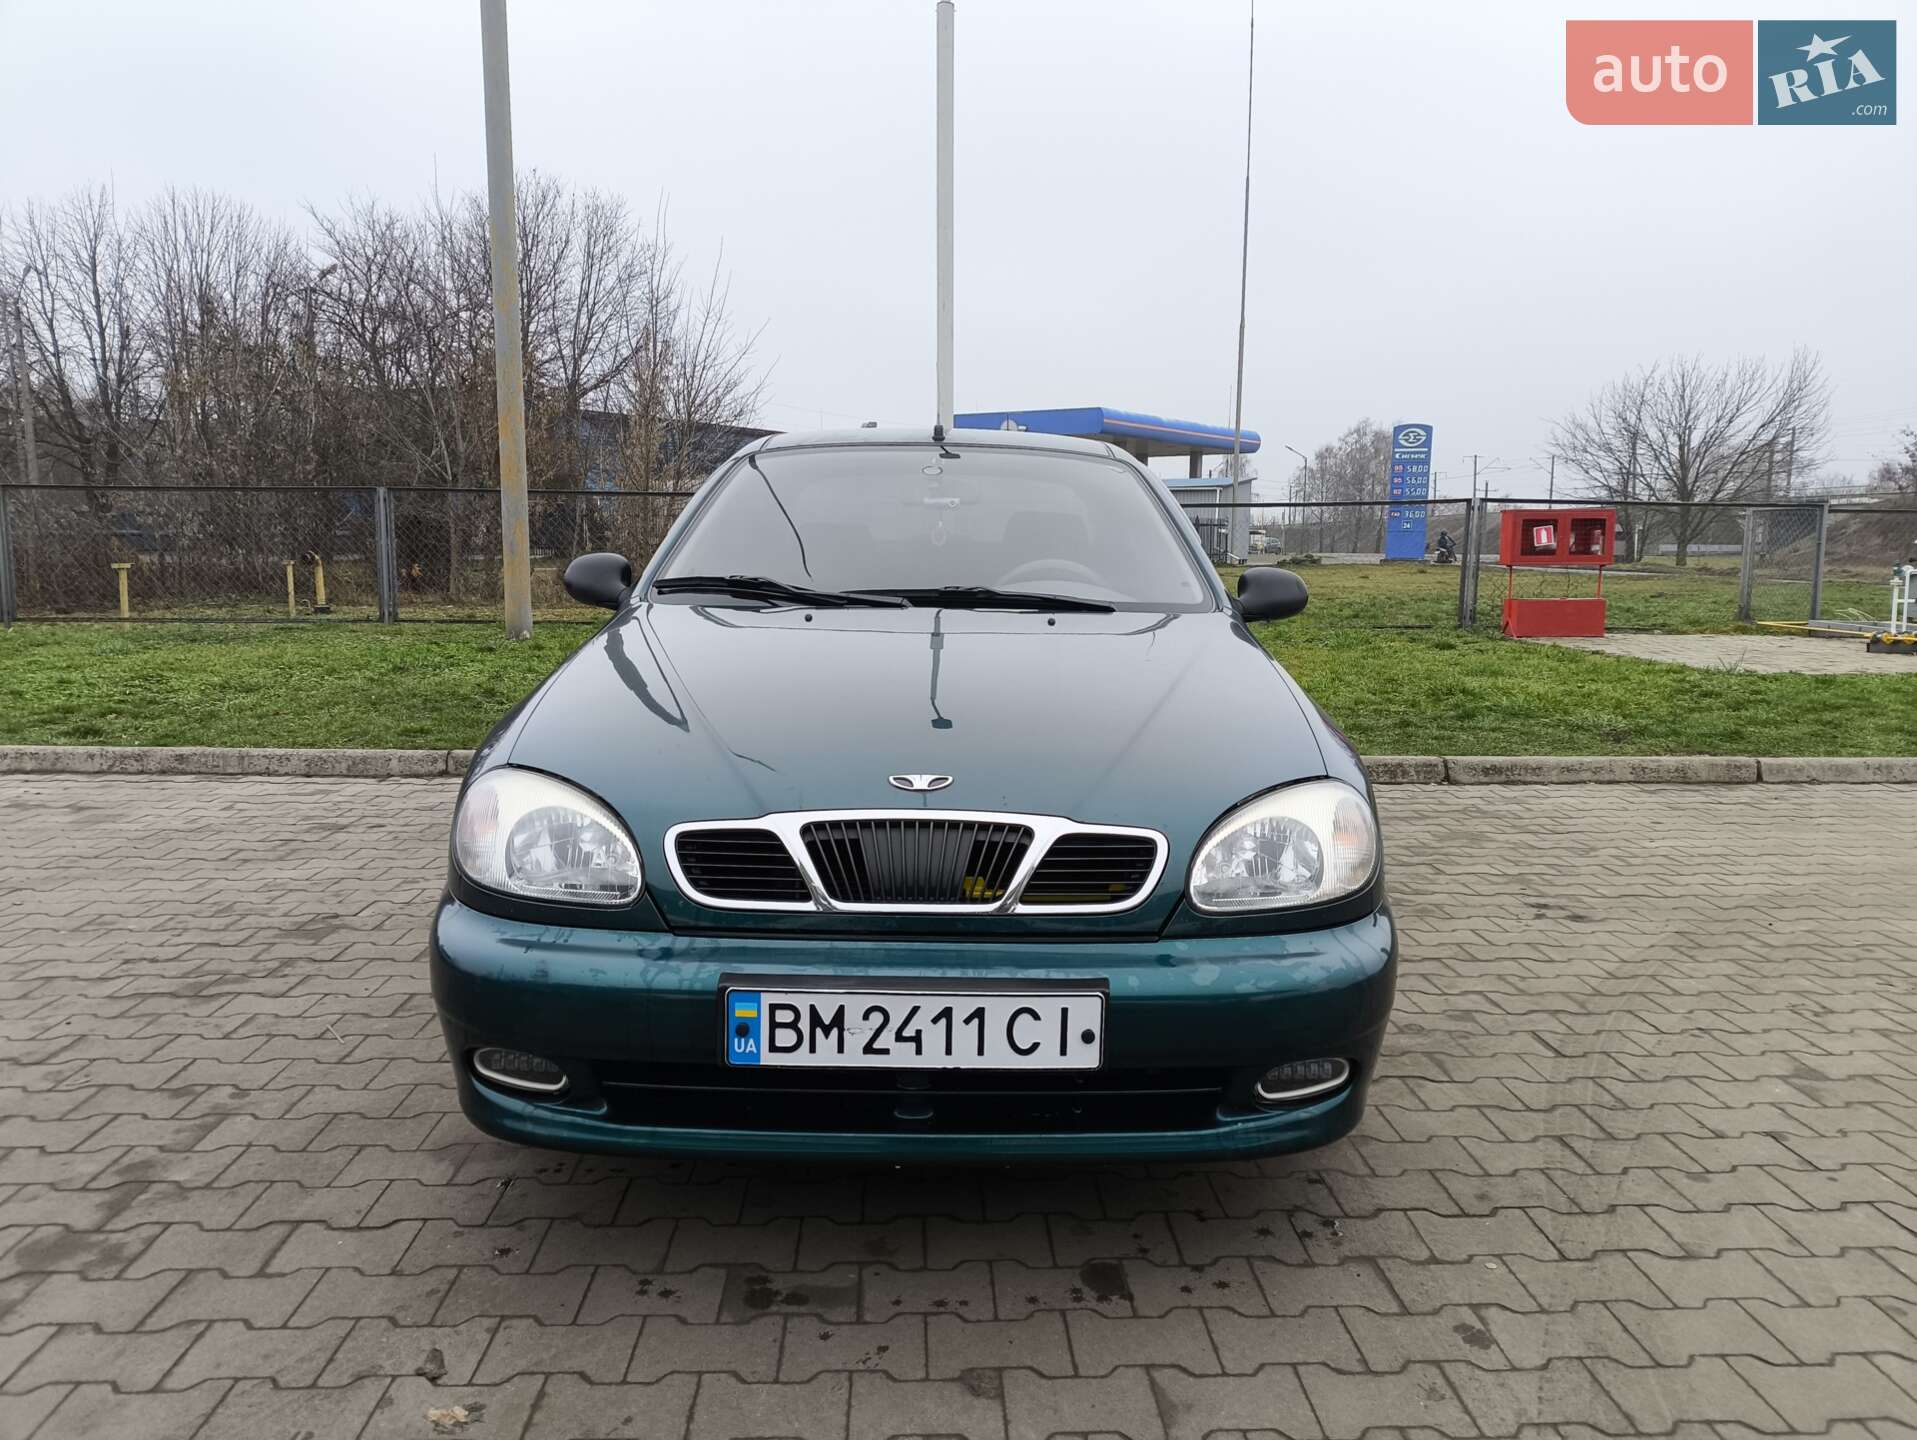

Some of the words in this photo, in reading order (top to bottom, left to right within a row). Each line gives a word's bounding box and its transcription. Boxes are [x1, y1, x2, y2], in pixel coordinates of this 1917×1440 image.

[734, 1038, 757, 1054] UA
[768, 1002, 845, 1054] BM
[861, 1005, 986, 1056] 2411
